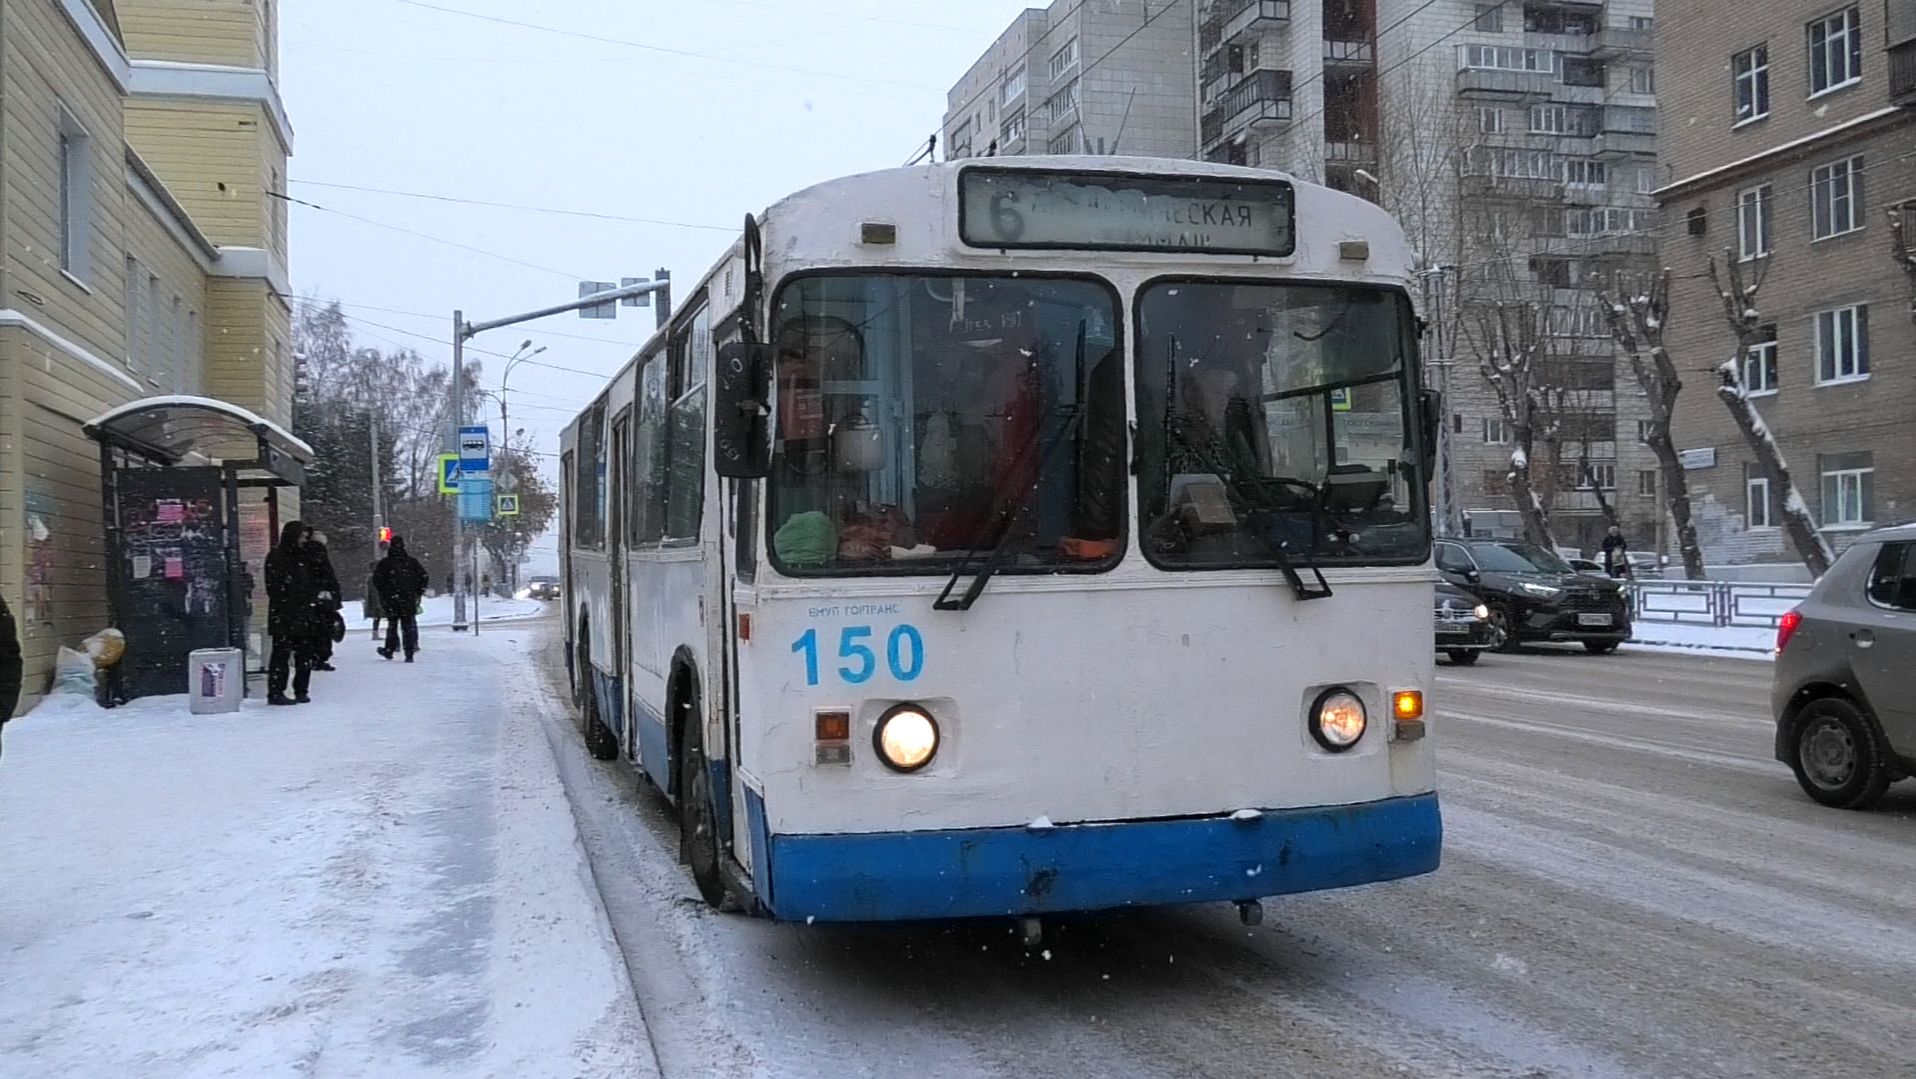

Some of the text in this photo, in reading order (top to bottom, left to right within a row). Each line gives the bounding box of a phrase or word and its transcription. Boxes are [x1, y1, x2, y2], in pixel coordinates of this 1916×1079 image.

[989, 190, 1026, 242] 6
[845, 603, 900, 616] ГОРТРАНС
[791, 623, 924, 686] 150
